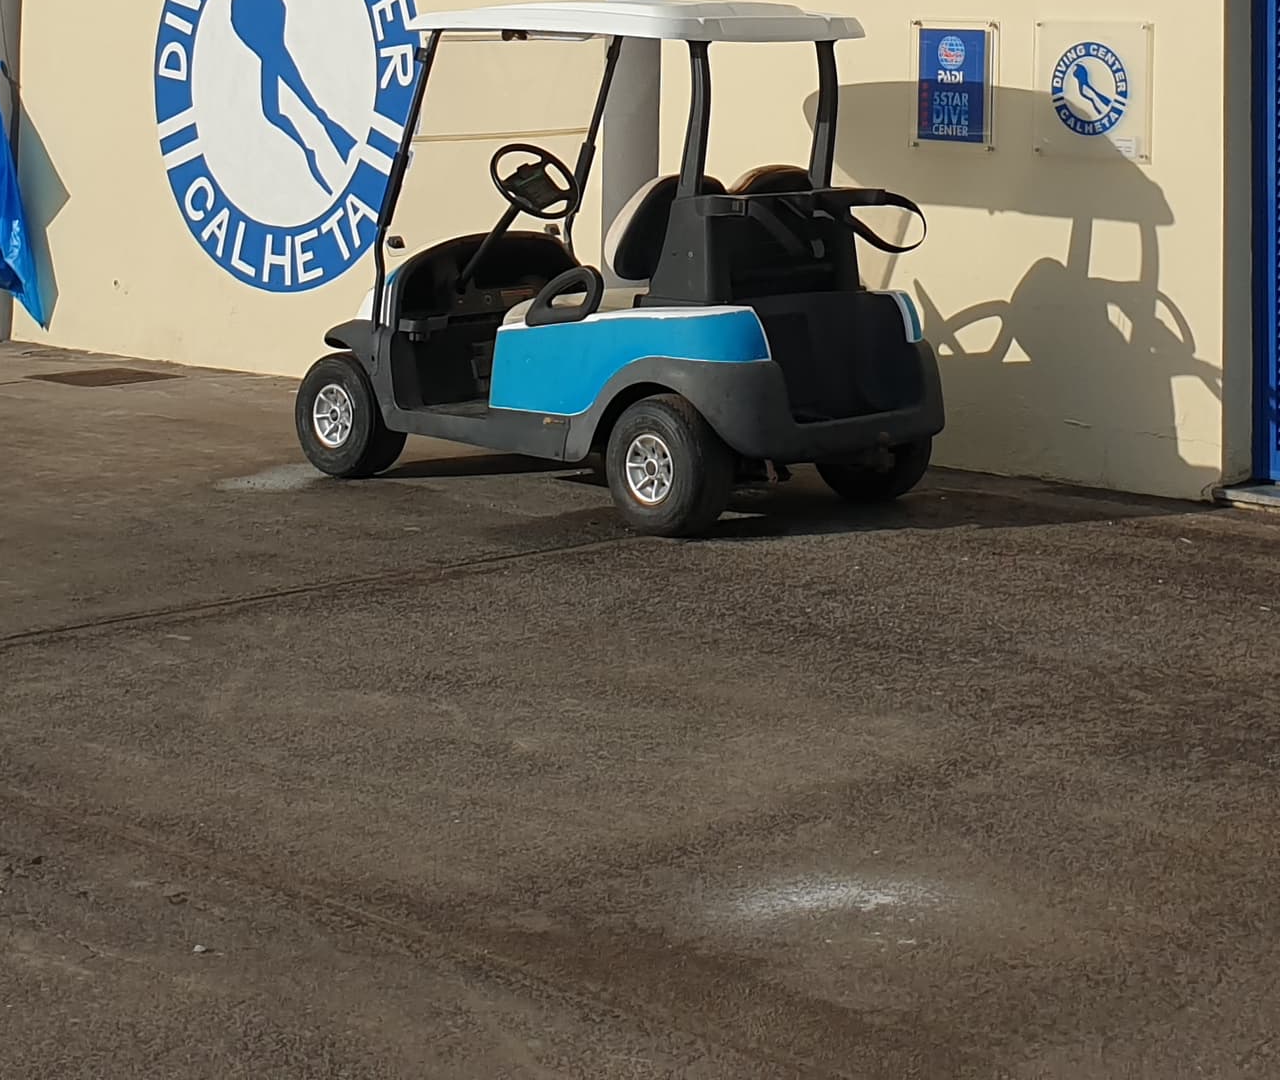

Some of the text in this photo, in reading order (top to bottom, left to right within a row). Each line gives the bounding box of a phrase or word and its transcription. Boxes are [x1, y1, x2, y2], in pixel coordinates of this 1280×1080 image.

[937, 69, 965, 84] PADI
[1053, 44, 1126, 92] DIVING CENTER
[932, 105, 969, 126] DIVE
[1060, 108, 1120, 134] CALHETA
[932, 123, 969, 137] CENTER
[184, 175, 380, 287] CALHETA
